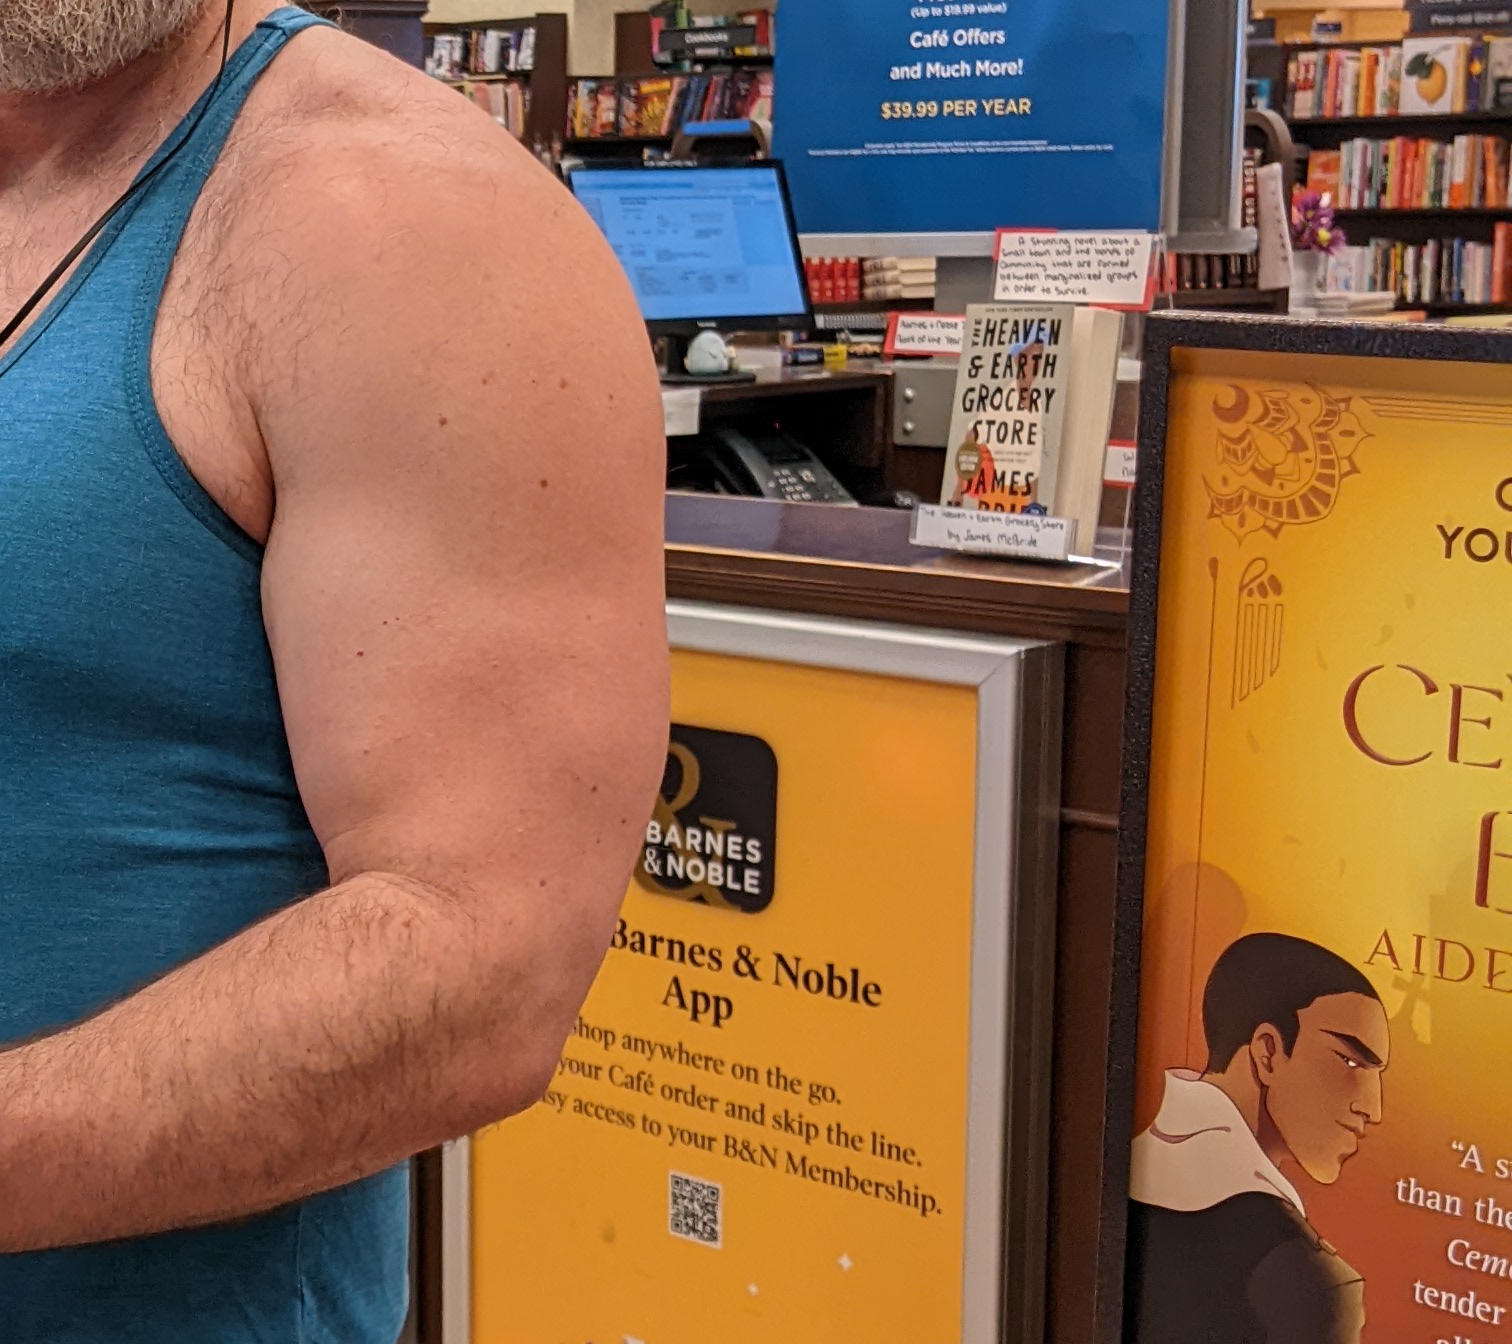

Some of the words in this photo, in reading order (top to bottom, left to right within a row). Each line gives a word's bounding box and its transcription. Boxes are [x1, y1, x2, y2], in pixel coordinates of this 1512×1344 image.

[910, 28, 948, 50] Café
[953, 27, 1006, 47] Offers
[889, 61, 921, 80] and
[926, 58, 971, 79] Much
[975, 57, 1024, 78] More!
[881, 100, 938, 120] $39.99
[943, 98, 977, 118] PER
[982, 97, 1032, 117] YEAR
[982, 317, 1062, 347] HEAVEN
[990, 351, 1057, 379] EARTH
[961, 383, 1056, 414] GROCERY
[972, 418, 1037, 446] STORE
[1436, 523, 1512, 565] YO
[1342, 663, 1512, 769] CE
[645, 819, 762, 864] BARNES
[643, 846, 663, 877] &
[666, 853, 761, 895] NOBLE
[609, 918, 723, 973] Barnes
[732, 944, 762, 983] &
[772, 951, 882, 1008] Noble
[661, 975, 734, 1030] App
[621, 1031, 725, 1076] anywhere
[730, 1061, 759, 1085] on
[766, 1066, 803, 1096] the
[808, 1079, 843, 1109] go.
[557, 1056, 603, 1081] your
[607, 1064, 655, 1096] Café
[660, 1078, 720, 1115] order
[724, 1097, 766, 1127] and
[771, 1112, 820, 1144] skip
[826, 1122, 864, 1152] the
[870, 1131, 923, 1168] line.
[572, 1096, 636, 1132] access
[640, 1115, 663, 1139] to
[667, 1122, 718, 1153] your
[722, 1134, 780, 1169] B&N
[784, 1150, 944, 1218] Membership.
[1395, 1177, 1463, 1217] than
[1412, 1278, 1506, 1327] tender
